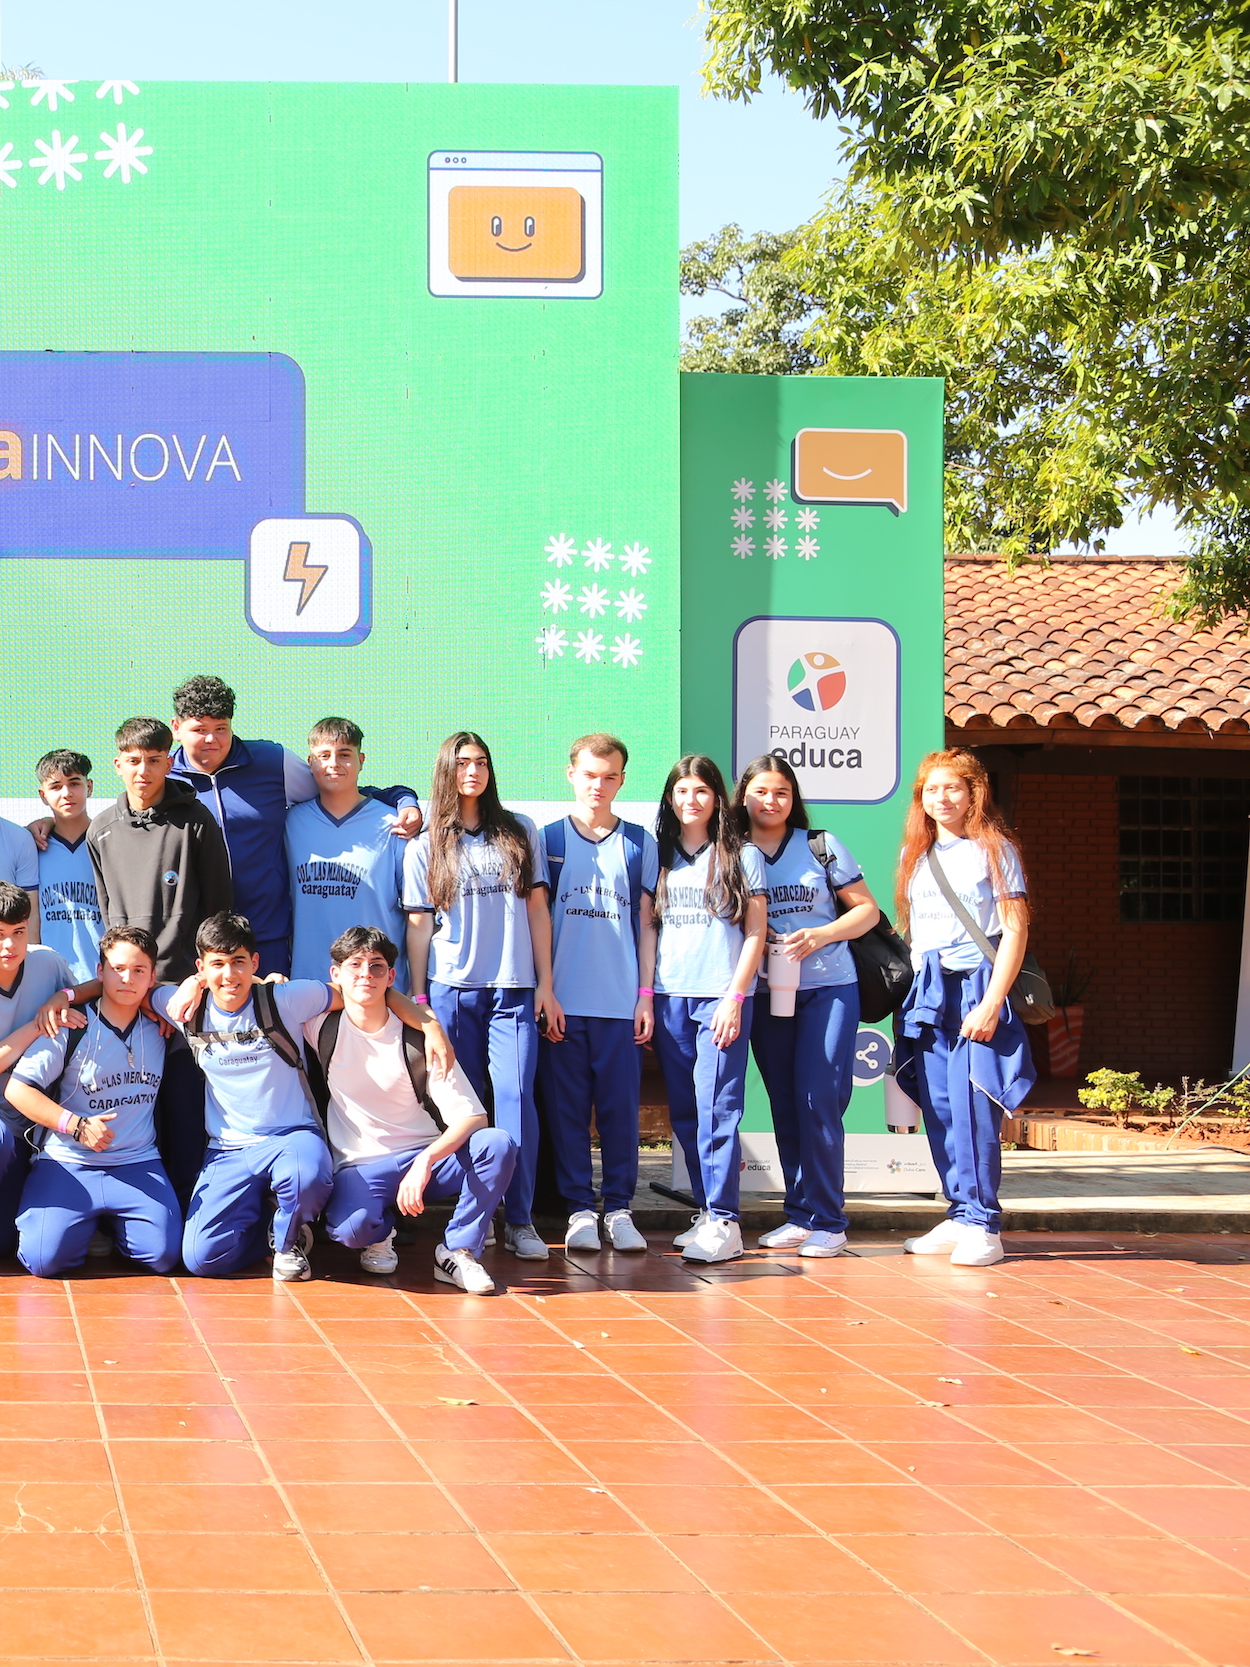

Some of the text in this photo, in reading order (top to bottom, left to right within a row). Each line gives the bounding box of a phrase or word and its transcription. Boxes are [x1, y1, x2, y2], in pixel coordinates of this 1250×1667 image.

[770, 725, 861, 740] PARAGUAY
[302, 884, 358, 900] caraguatay
[566, 907, 622, 921] caraguatay
[767, 904, 814, 919] aguatay
[663, 912, 713, 929] raguatay
[218, 1056, 258, 1067] Caraguatay
